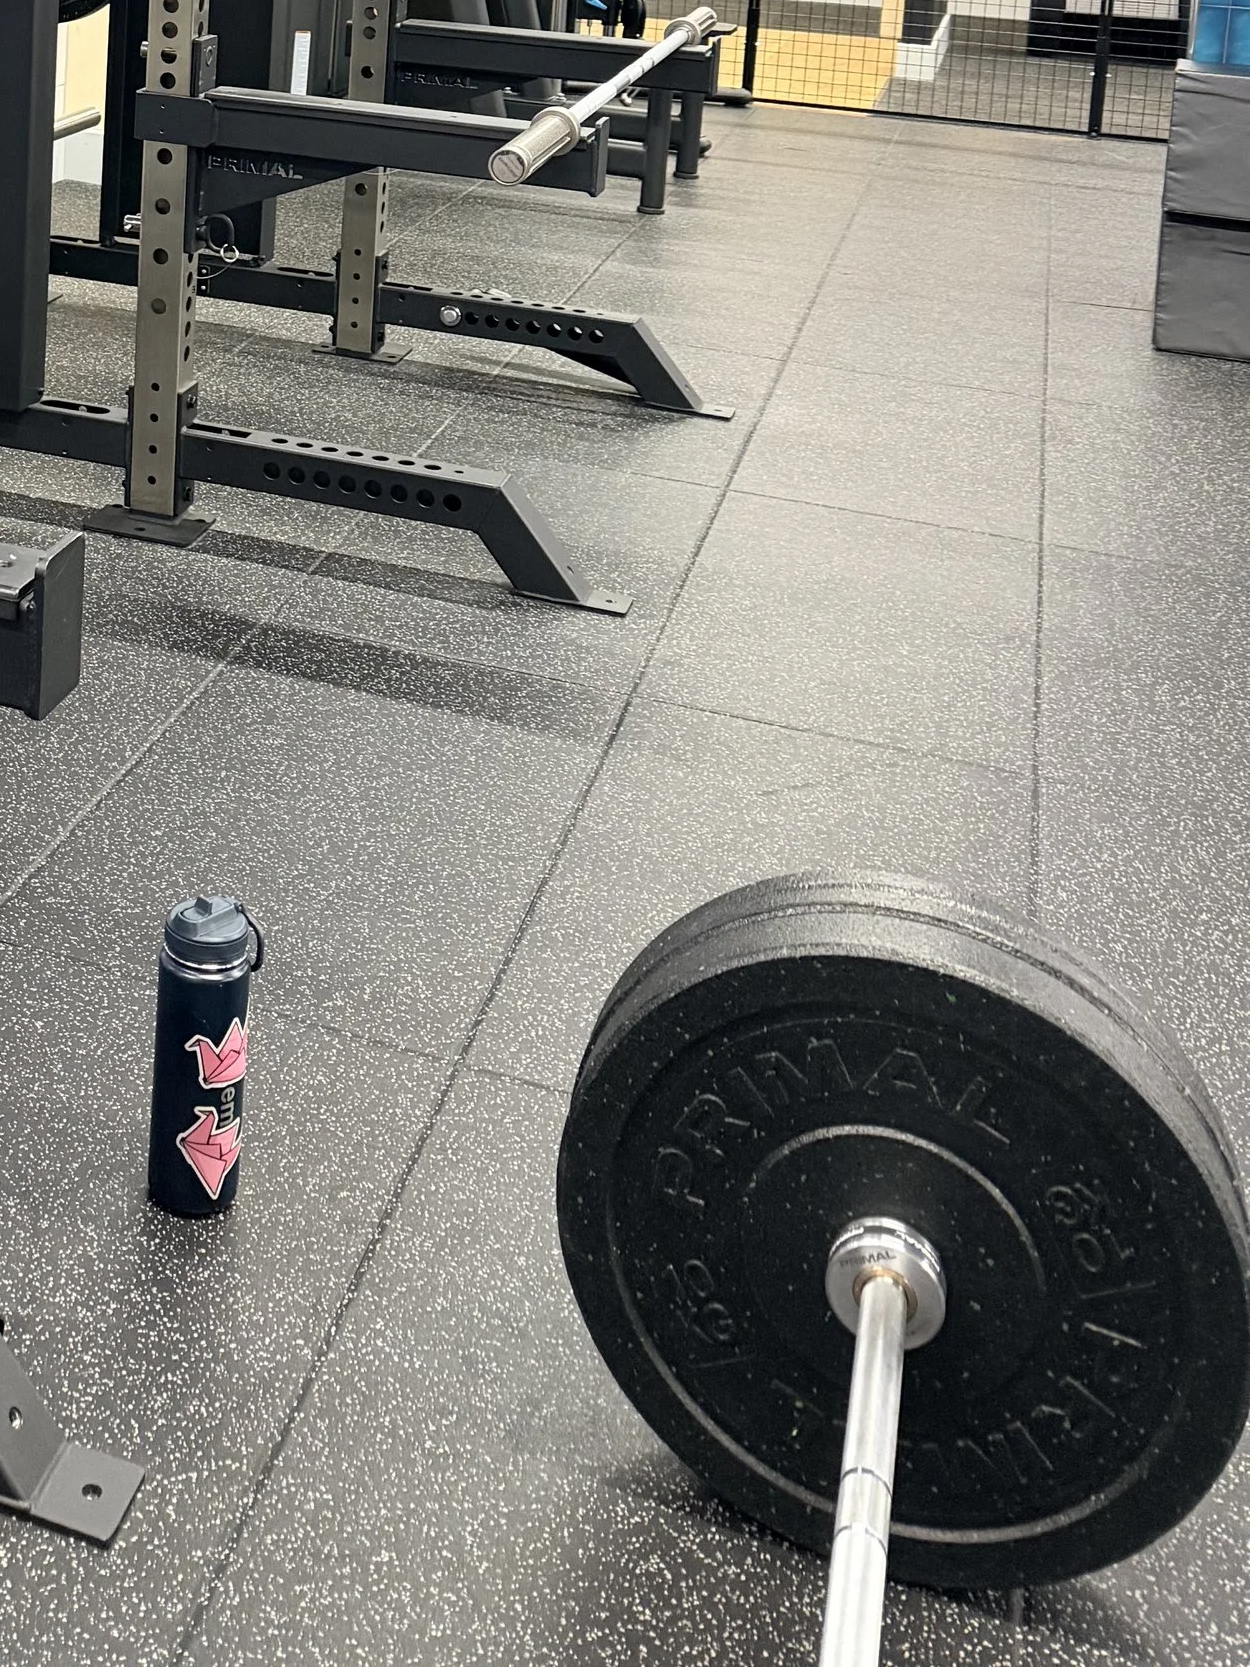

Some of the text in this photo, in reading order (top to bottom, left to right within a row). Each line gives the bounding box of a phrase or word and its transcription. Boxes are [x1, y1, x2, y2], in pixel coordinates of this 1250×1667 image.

[208, 154, 304, 180] PRIMAL
[652, 1036, 1012, 1208] PRIMAL
[837, 1250, 897, 1268] PRIMAL
